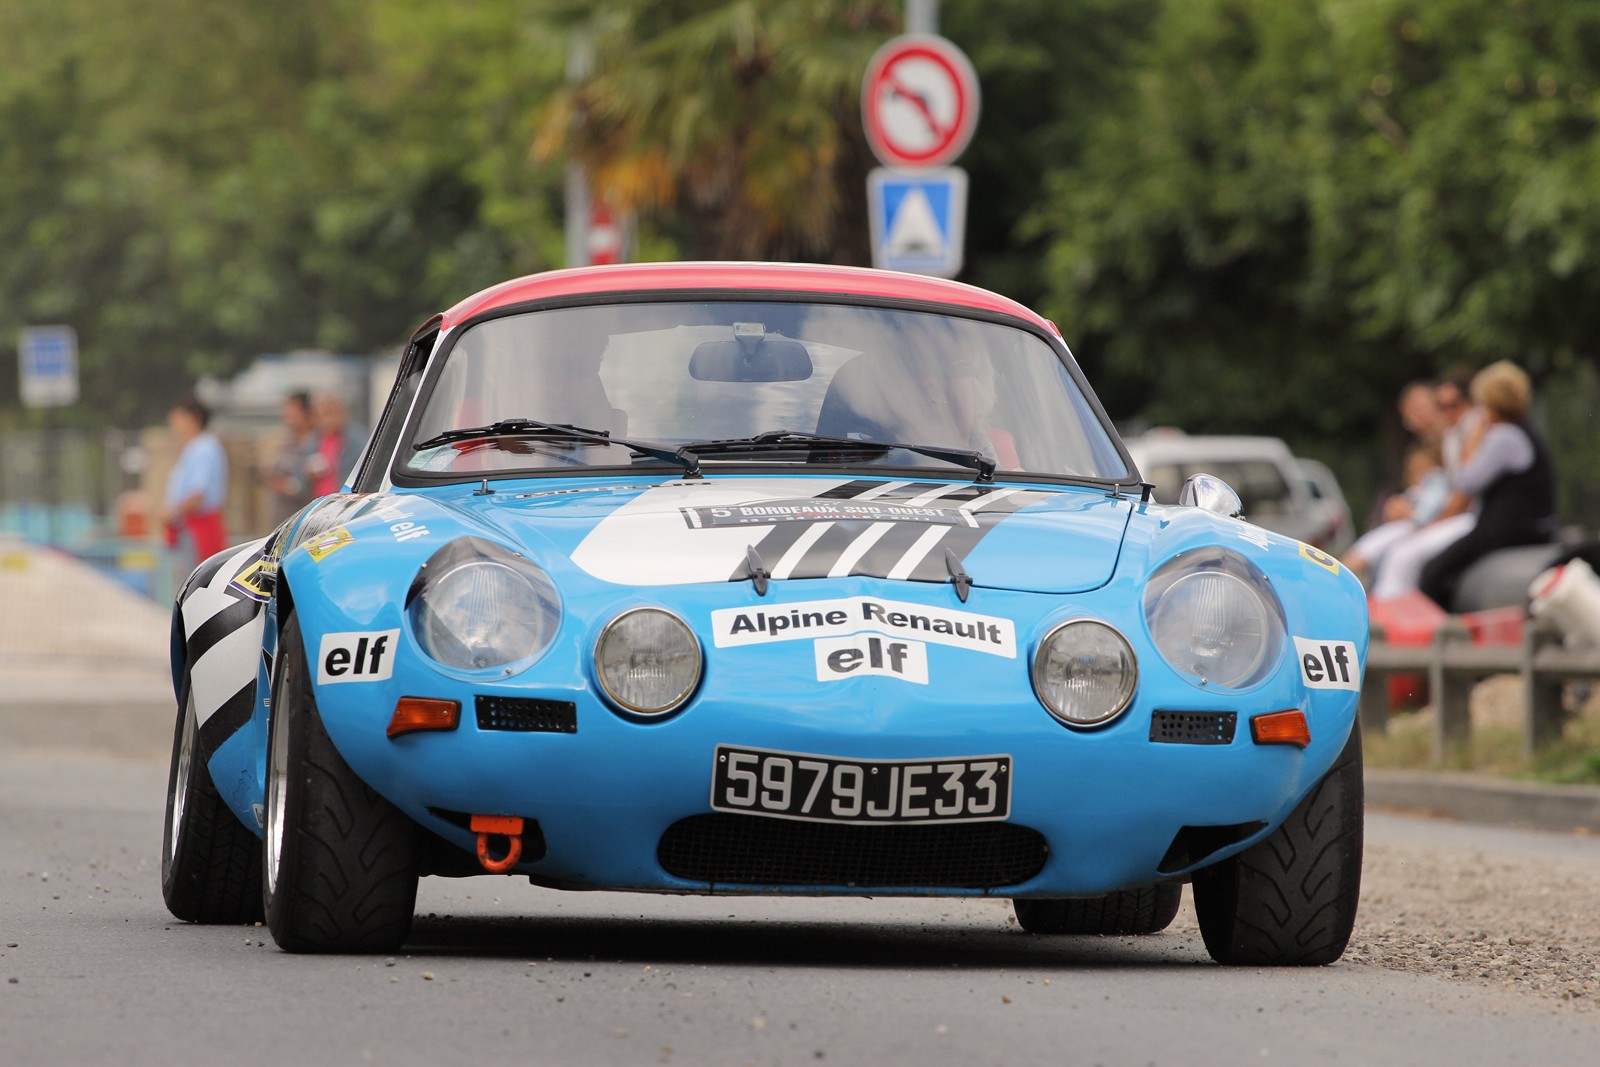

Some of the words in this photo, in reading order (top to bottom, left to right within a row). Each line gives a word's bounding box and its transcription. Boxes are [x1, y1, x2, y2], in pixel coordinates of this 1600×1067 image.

[740, 505, 841, 516] BORDEAUX
[390, 522, 430, 543] elf
[730, 609, 848, 636] Alpine
[862, 602, 1002, 645] Renault
[325, 635, 388, 677] elf
[827, 637, 908, 674] elf
[1303, 645, 1350, 683] elf
[726, 752, 999, 818] 5979JE33
